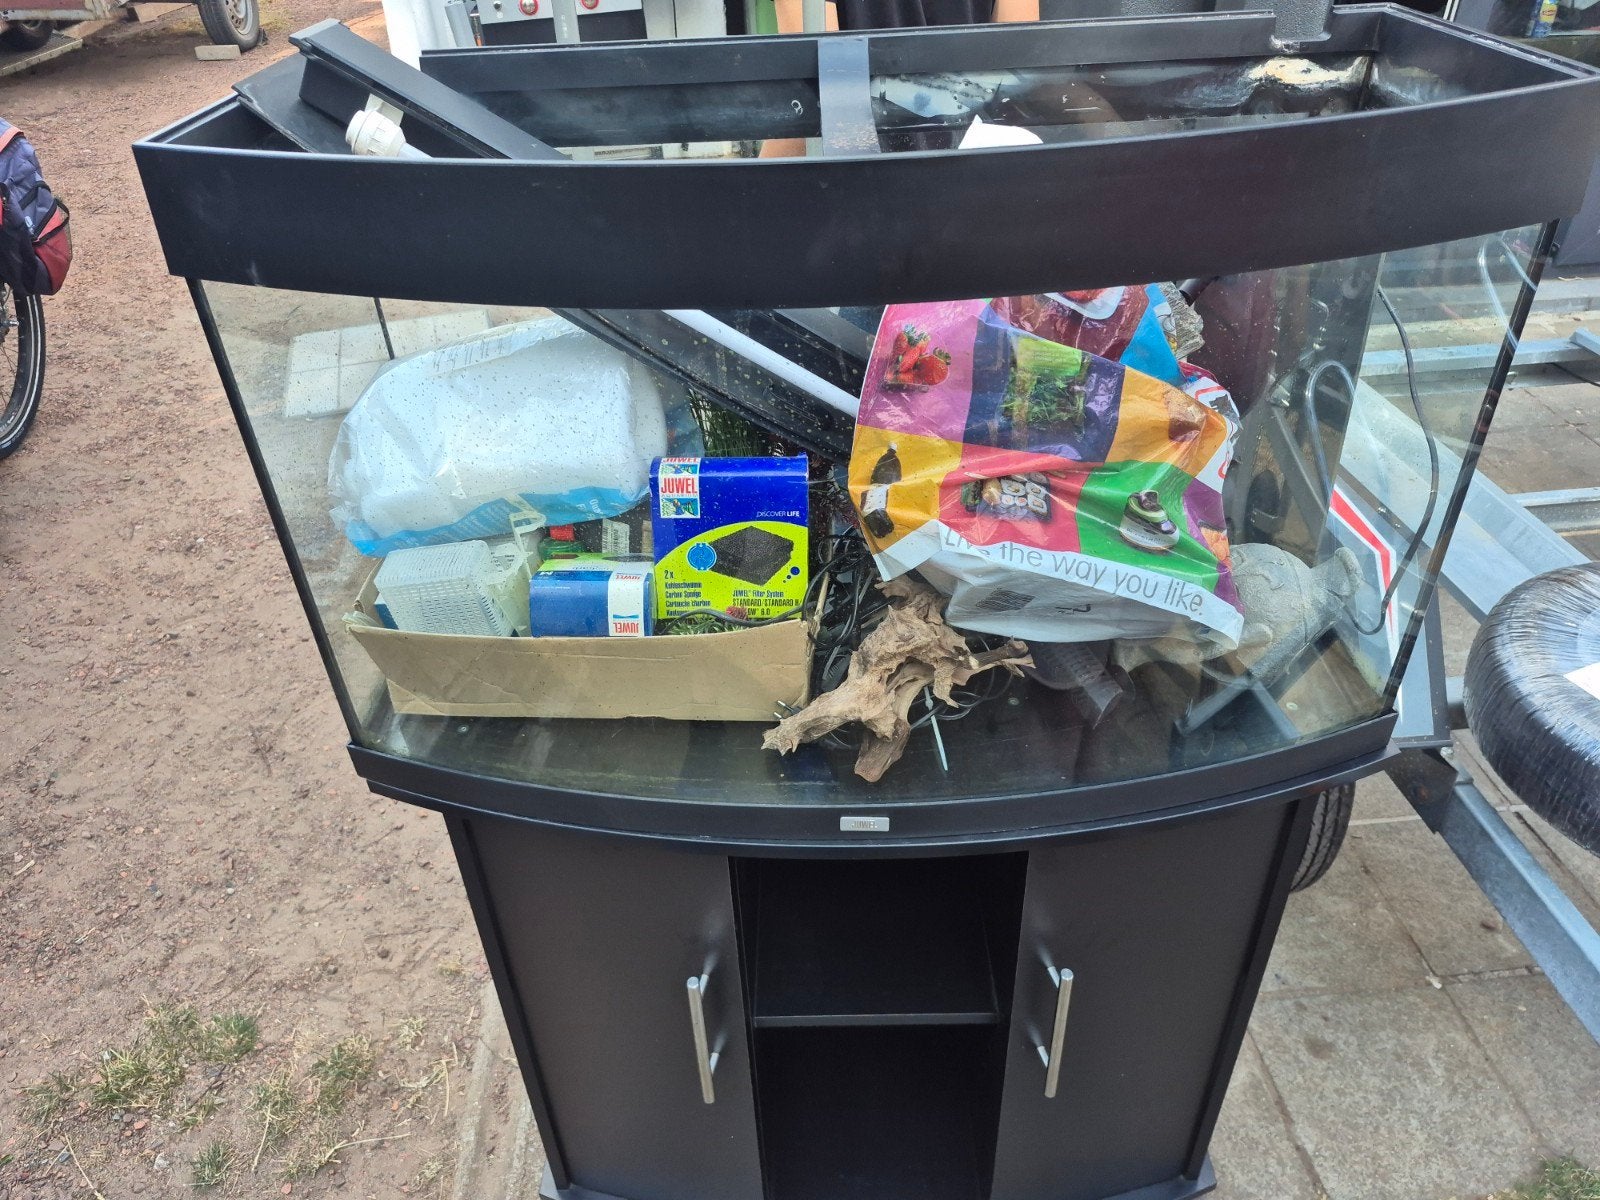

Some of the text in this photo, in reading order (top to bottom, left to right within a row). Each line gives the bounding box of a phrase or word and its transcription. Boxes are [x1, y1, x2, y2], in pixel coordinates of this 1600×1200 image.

[661, 478, 697, 494] JUWEL
[1000, 541, 1042, 567] the
[1052, 554, 1107, 589] way
[1115, 569, 1158, 596] you
[1163, 578, 1203, 616] like.
[613, 622, 639, 633] JUWEL
